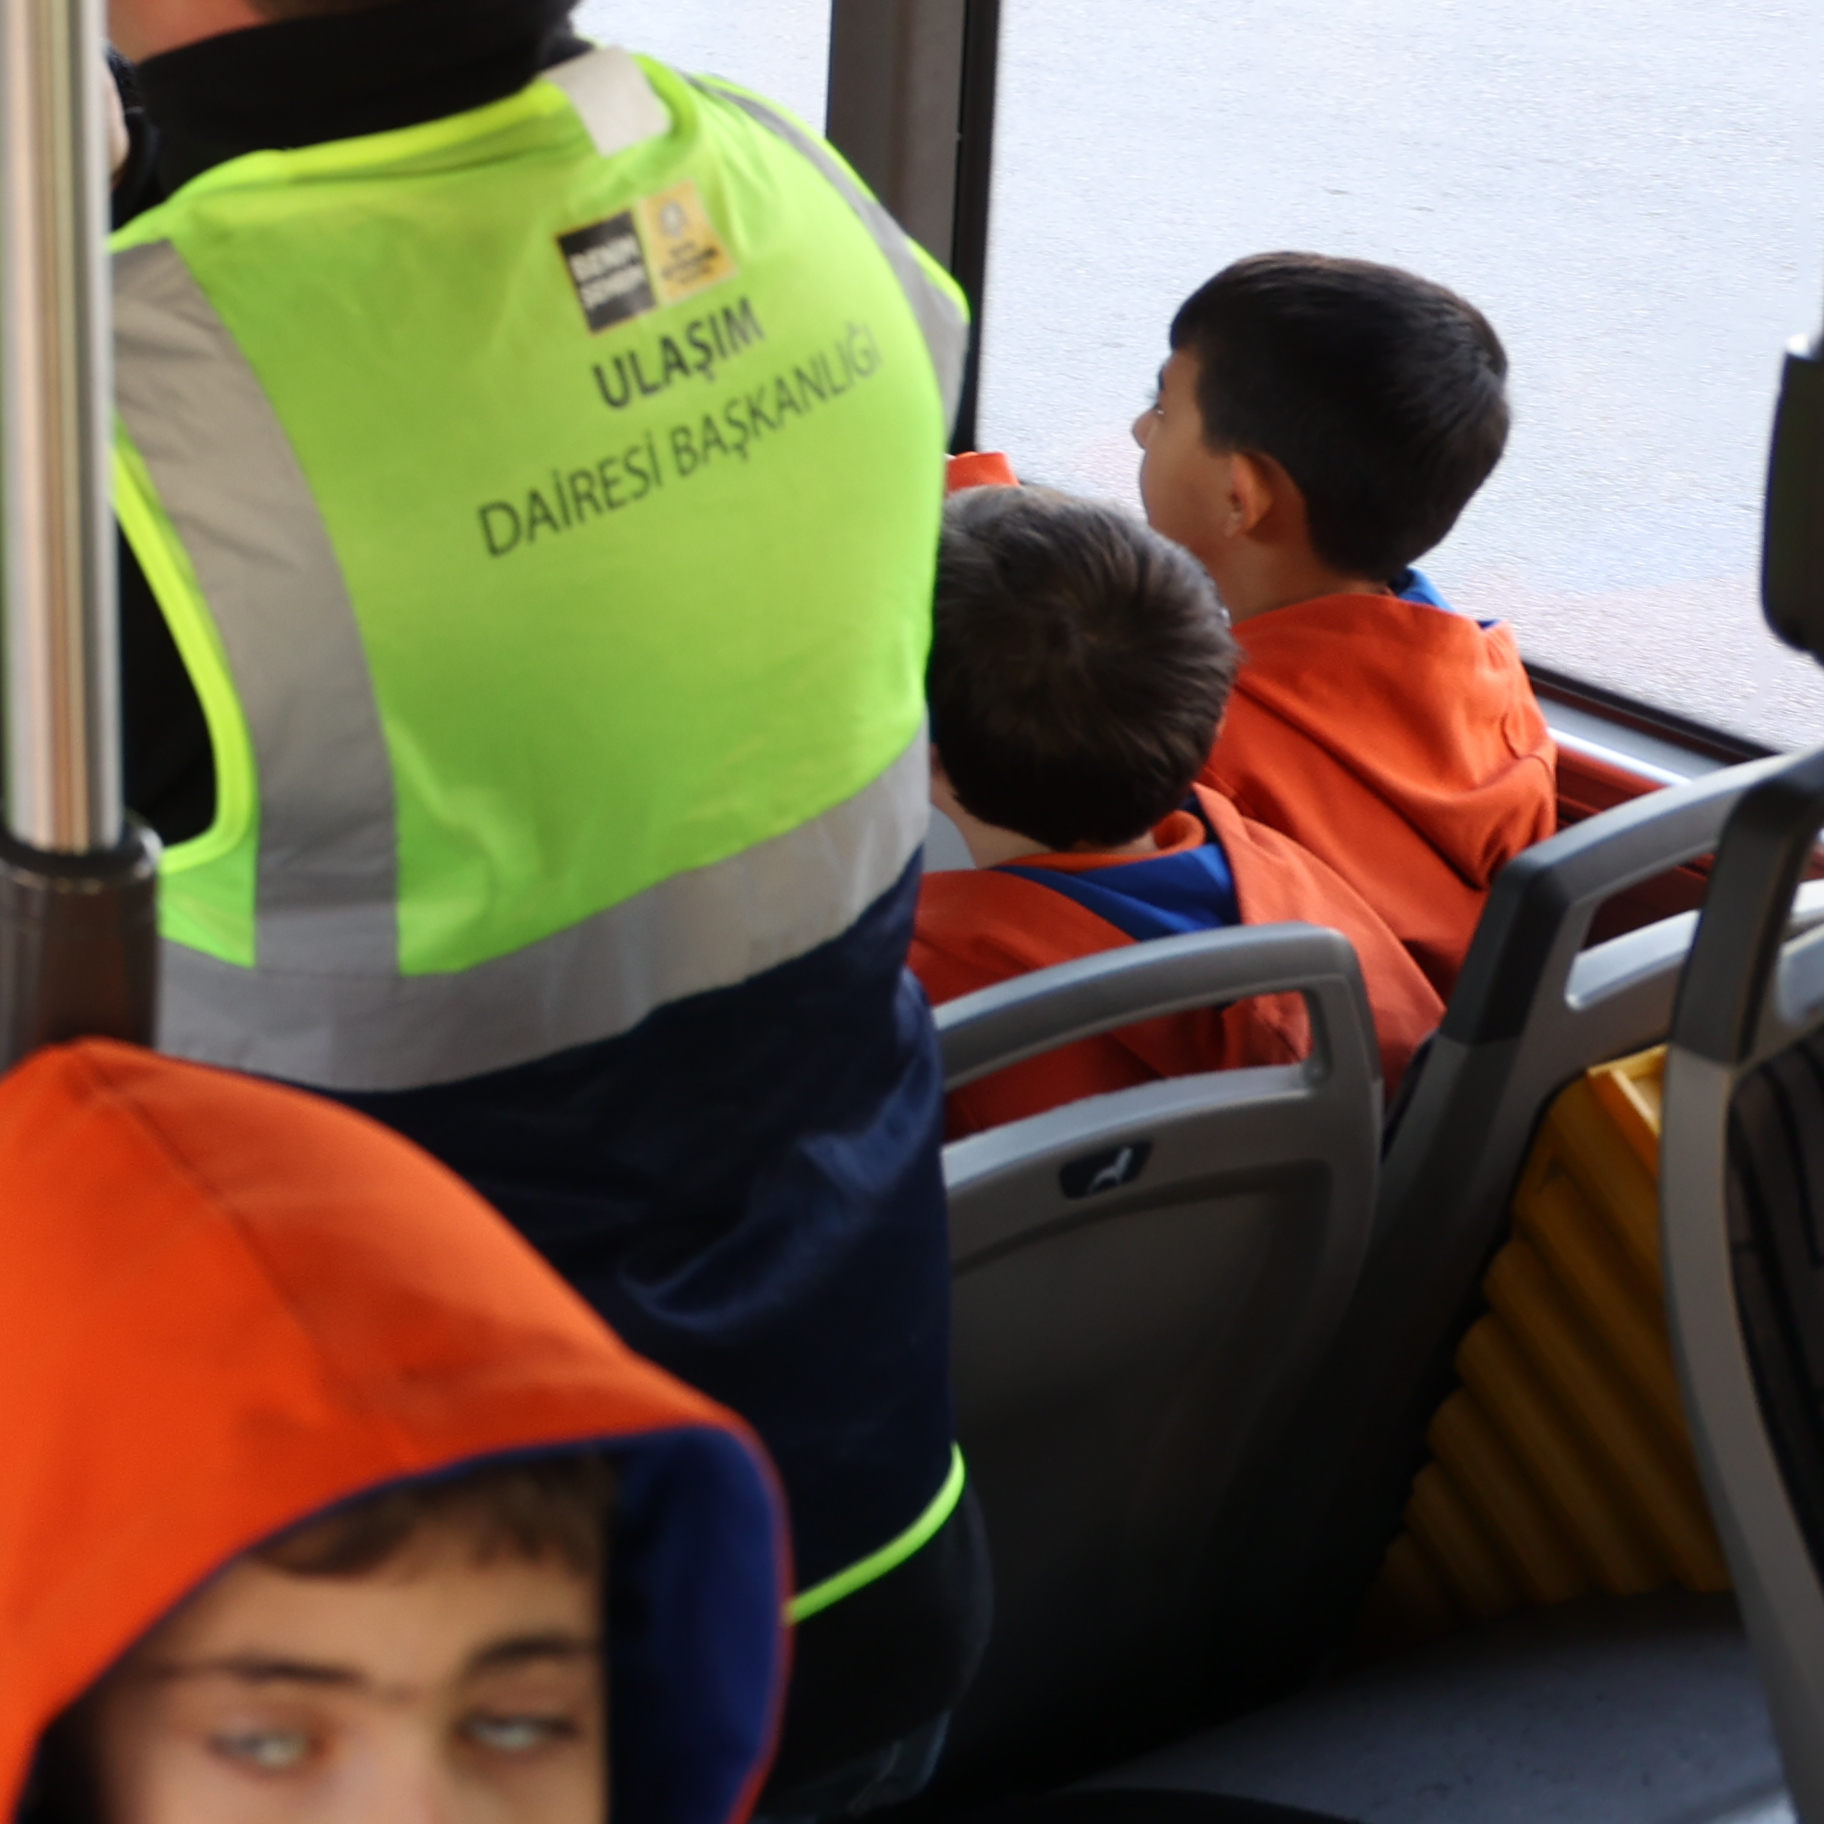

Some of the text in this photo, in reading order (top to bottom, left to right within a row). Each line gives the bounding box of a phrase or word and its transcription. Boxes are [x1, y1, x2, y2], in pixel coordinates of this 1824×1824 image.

[478, 320, 884, 558] DAİRESİ BAŞKANLIĞI
[592, 296, 767, 412] ULAŞIM
